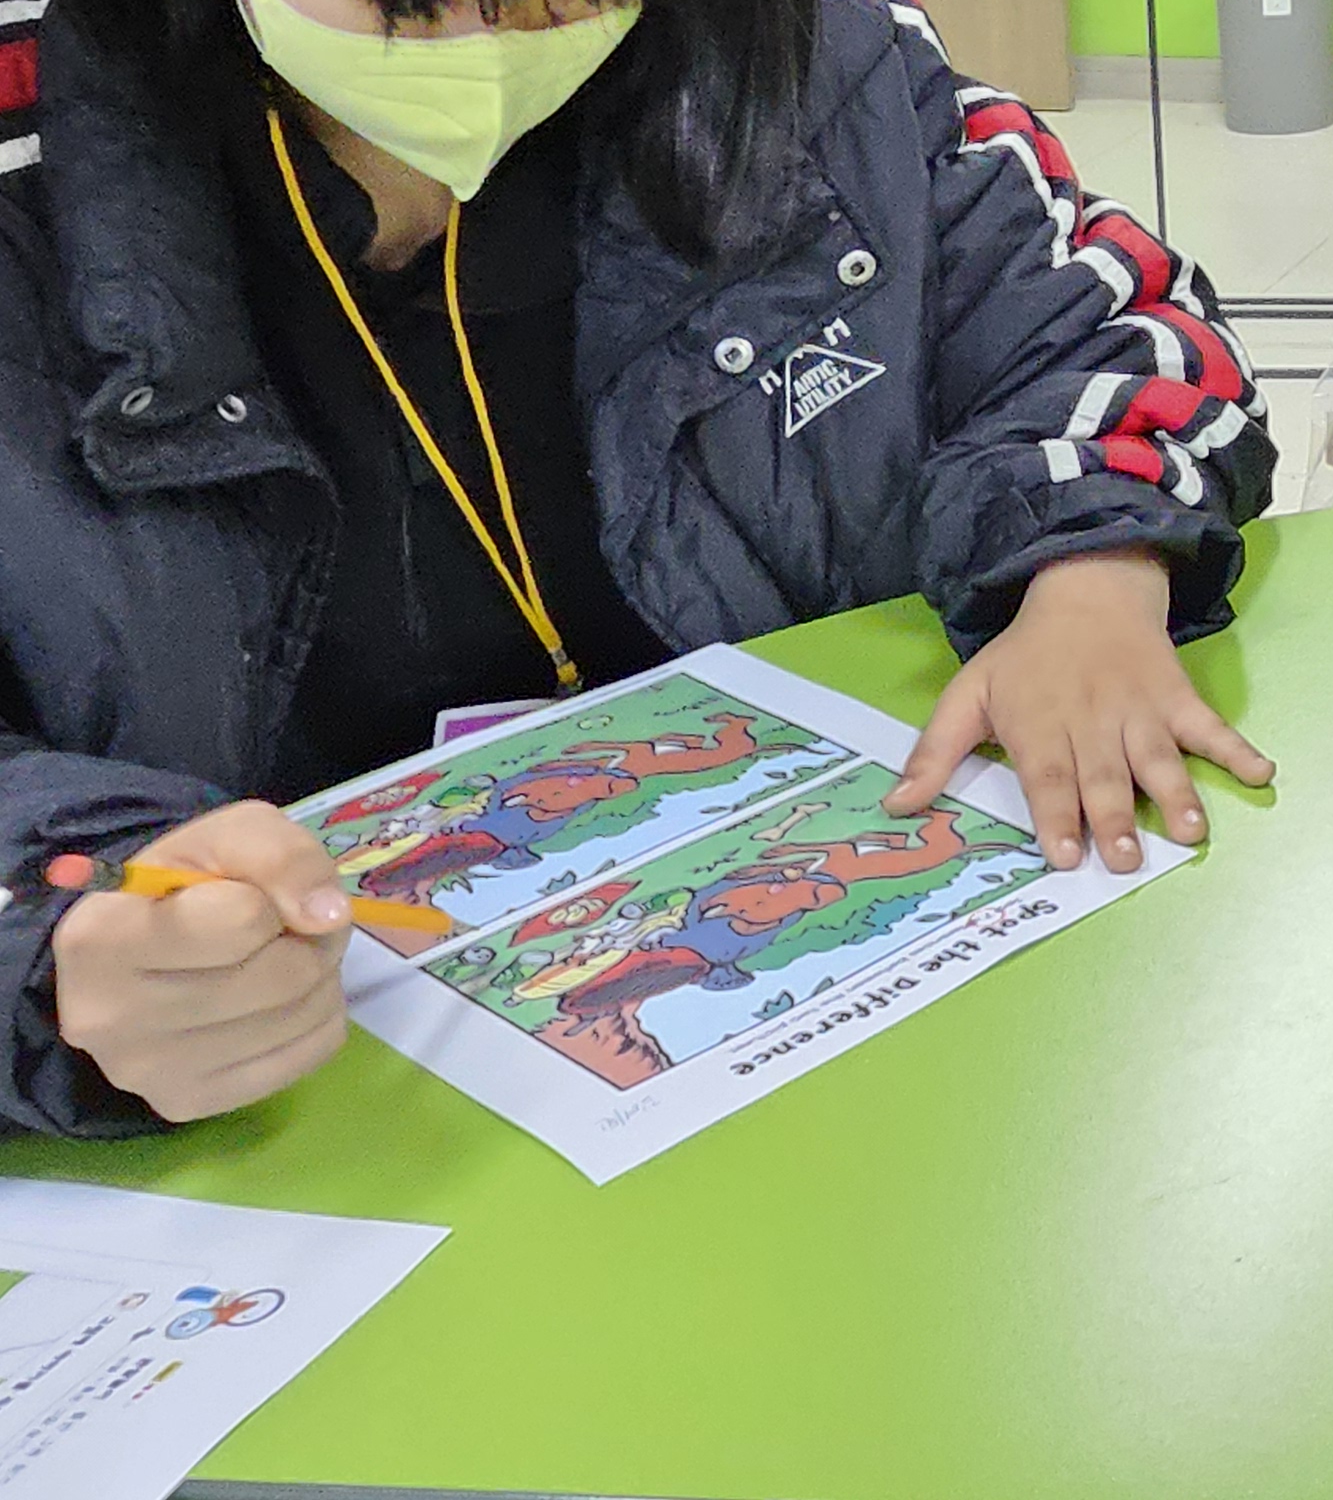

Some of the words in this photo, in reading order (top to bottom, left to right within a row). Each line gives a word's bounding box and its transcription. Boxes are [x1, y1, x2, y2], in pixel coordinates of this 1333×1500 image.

[979, 899, 1059, 939] Spot
[918, 940, 982, 972] the
[729, 976, 922, 1076] Difference
